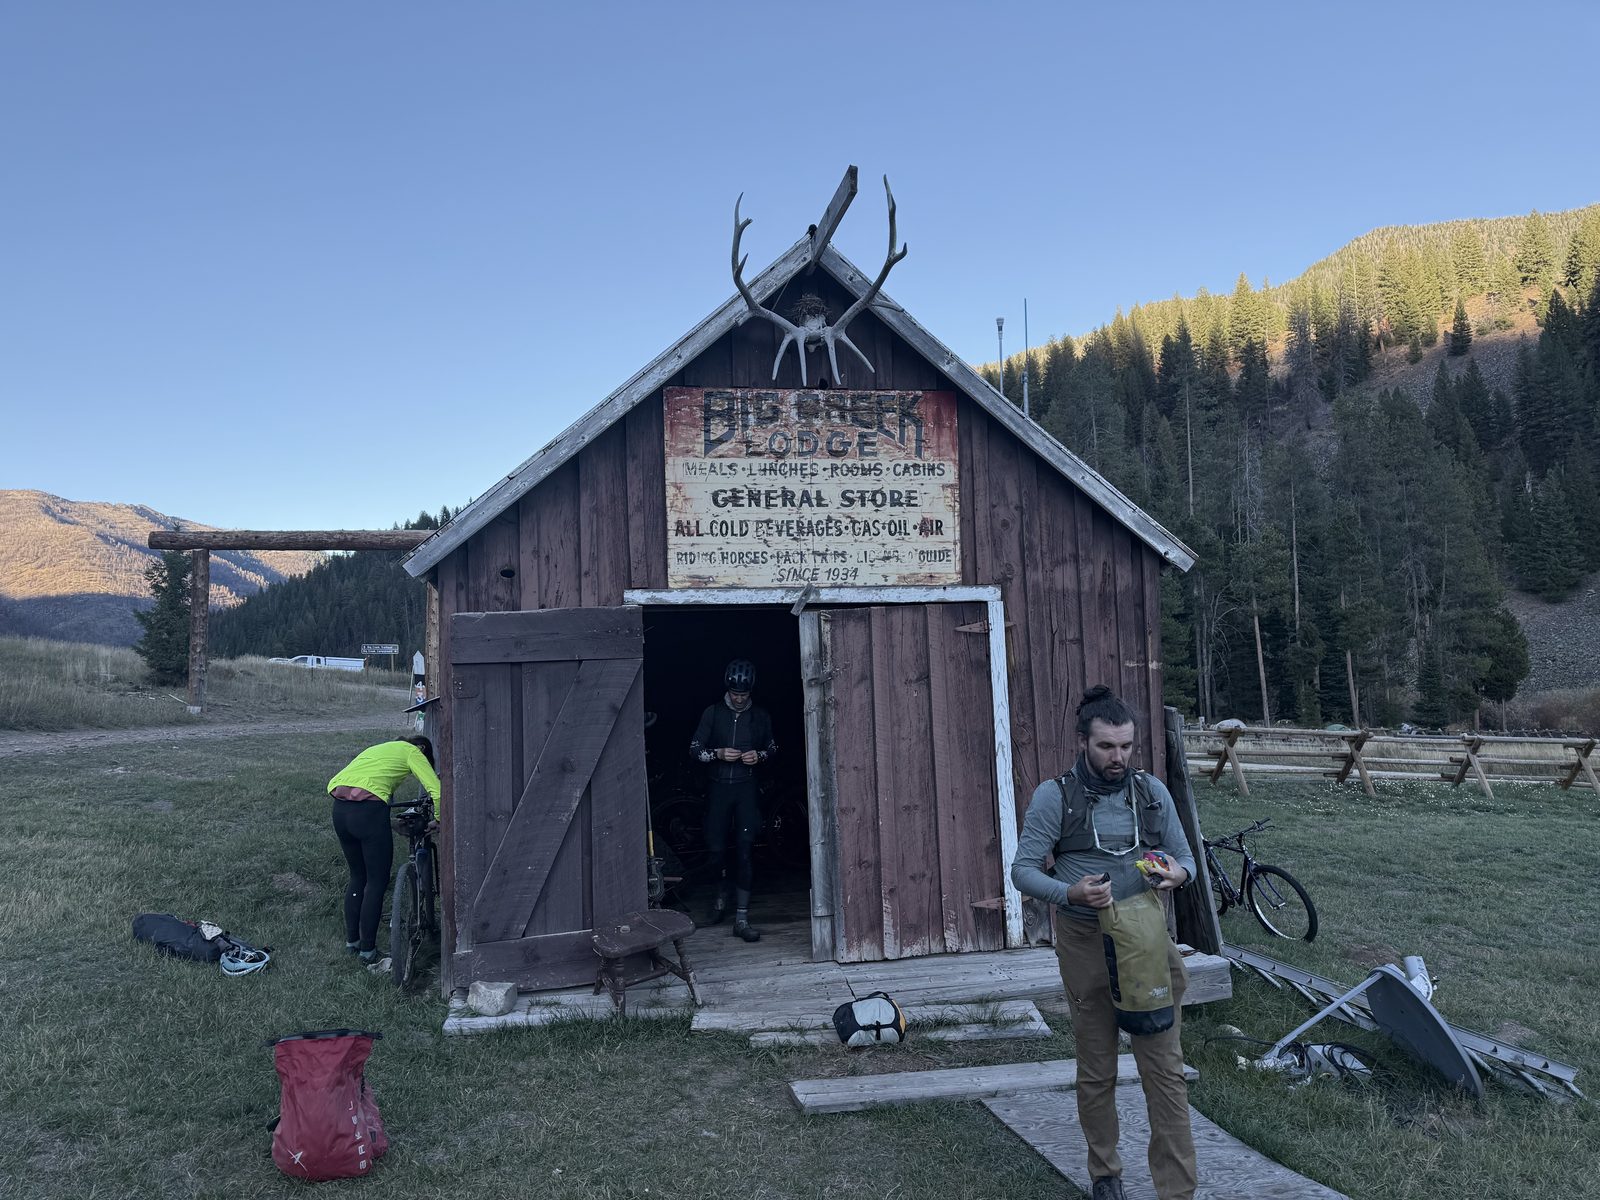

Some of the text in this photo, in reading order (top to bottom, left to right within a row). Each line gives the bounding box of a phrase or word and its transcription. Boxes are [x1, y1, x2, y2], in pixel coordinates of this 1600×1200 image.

[745, 430, 879, 458] LODGE
[683, 461, 945, 477] MEALS LUNCHES ROOMS CABINS
[711, 488, 919, 508] GENERAL STORE
[674, 519, 944, 537] ALL COLD BEVERAGES GAS OIL AIR
[720, 551, 769, 565] HORSES
[811, 550, 848, 564] TRPS
[918, 550, 952, 562] GUIDE
[777, 567, 859, 582] SINCE 1934
